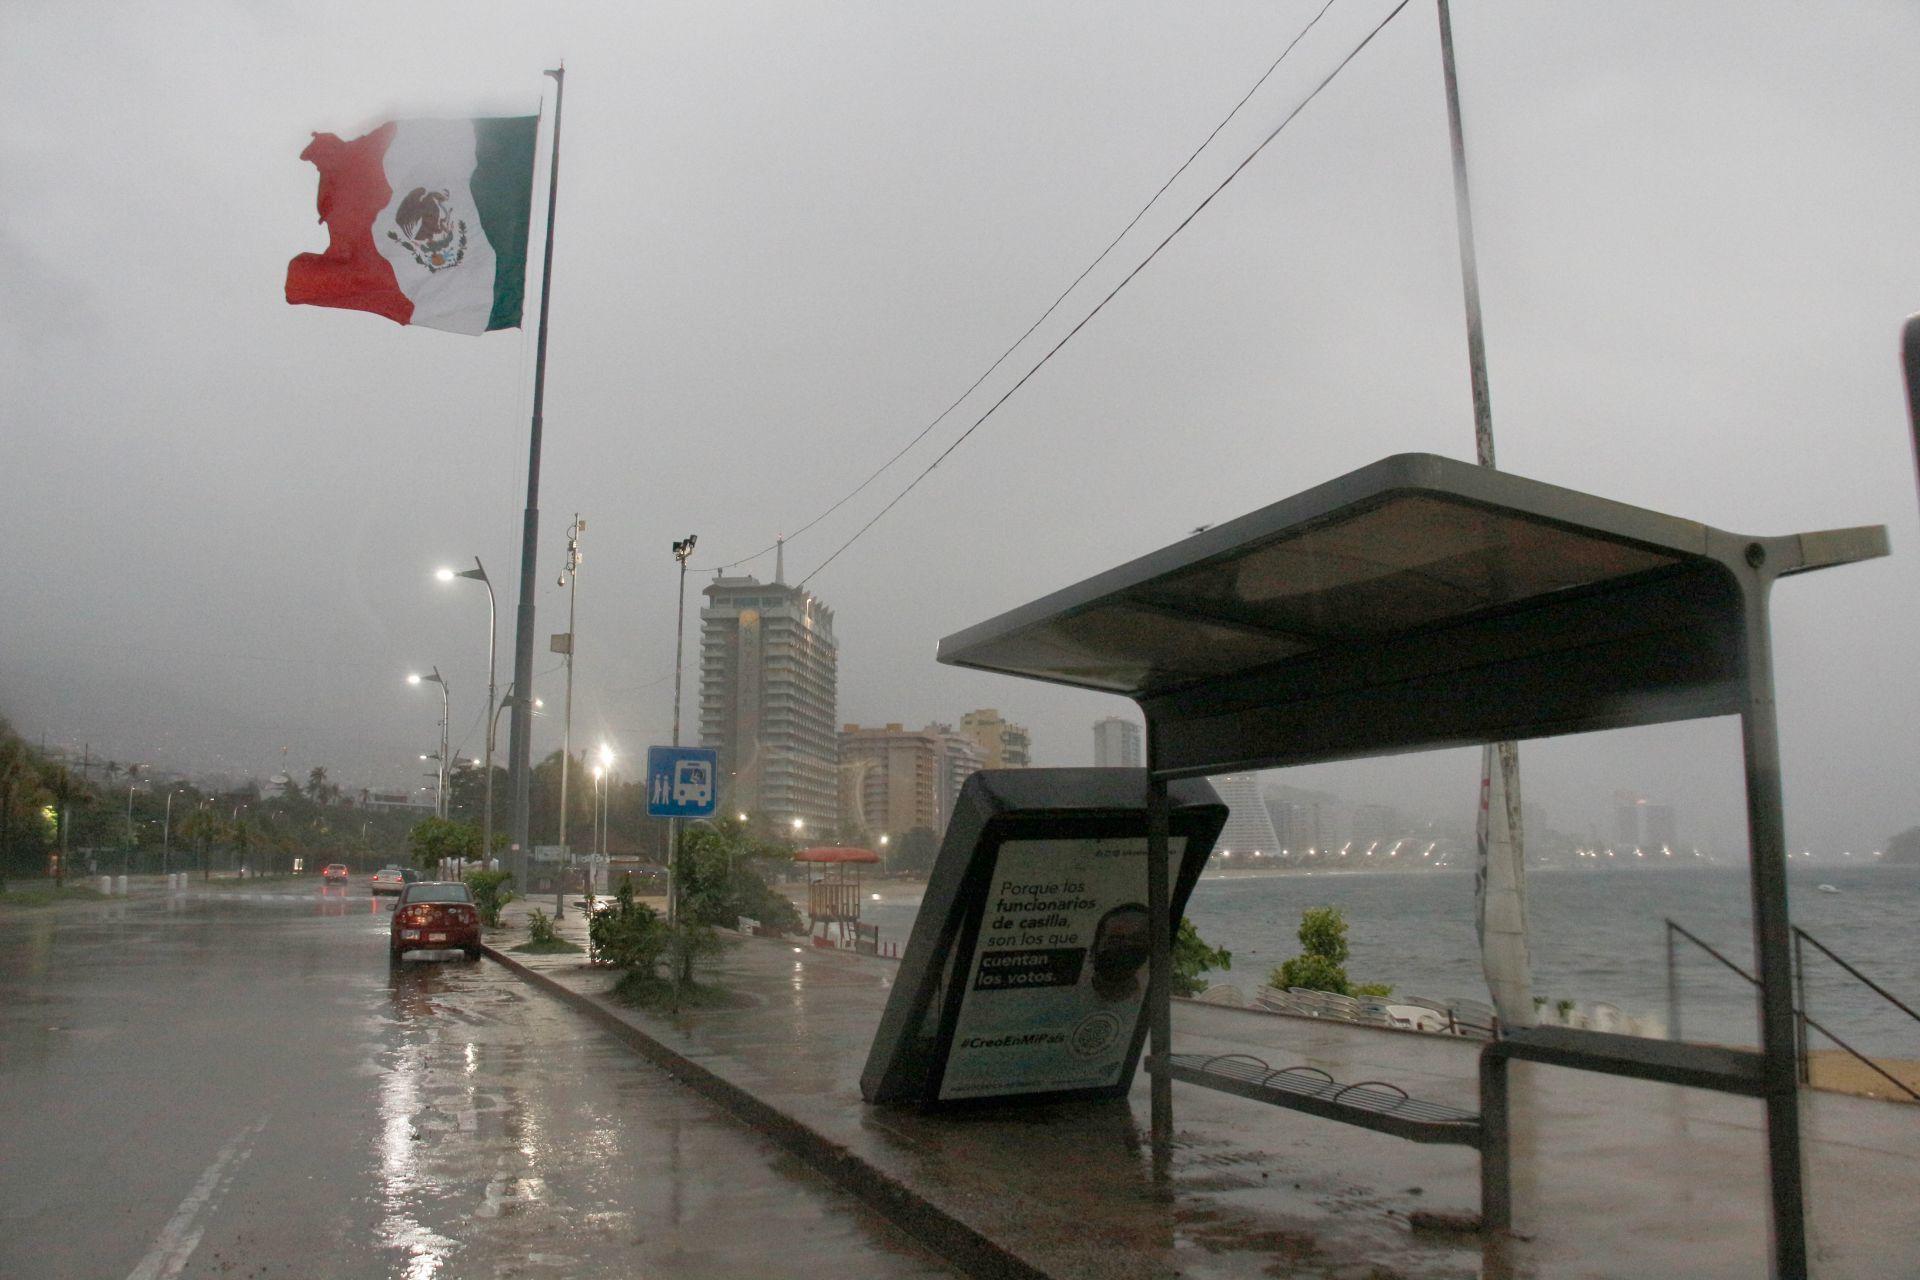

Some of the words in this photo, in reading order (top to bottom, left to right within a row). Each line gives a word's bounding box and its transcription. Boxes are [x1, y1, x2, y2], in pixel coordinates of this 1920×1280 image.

[1000, 881, 1059, 897] Porque
[1062, 880, 1086, 893] los
[996, 897, 1097, 913] funcionarios
[992, 916, 1014, 930] de
[1019, 914, 1071, 930] casilla,
[987, 935, 1016, 947] son
[1020, 933, 1043, 946] los
[1048, 933, 1079, 949] que
[982, 954, 1049, 968] cuentan
[978, 971, 1001, 986] los
[1007, 971, 1057, 985] votos.
